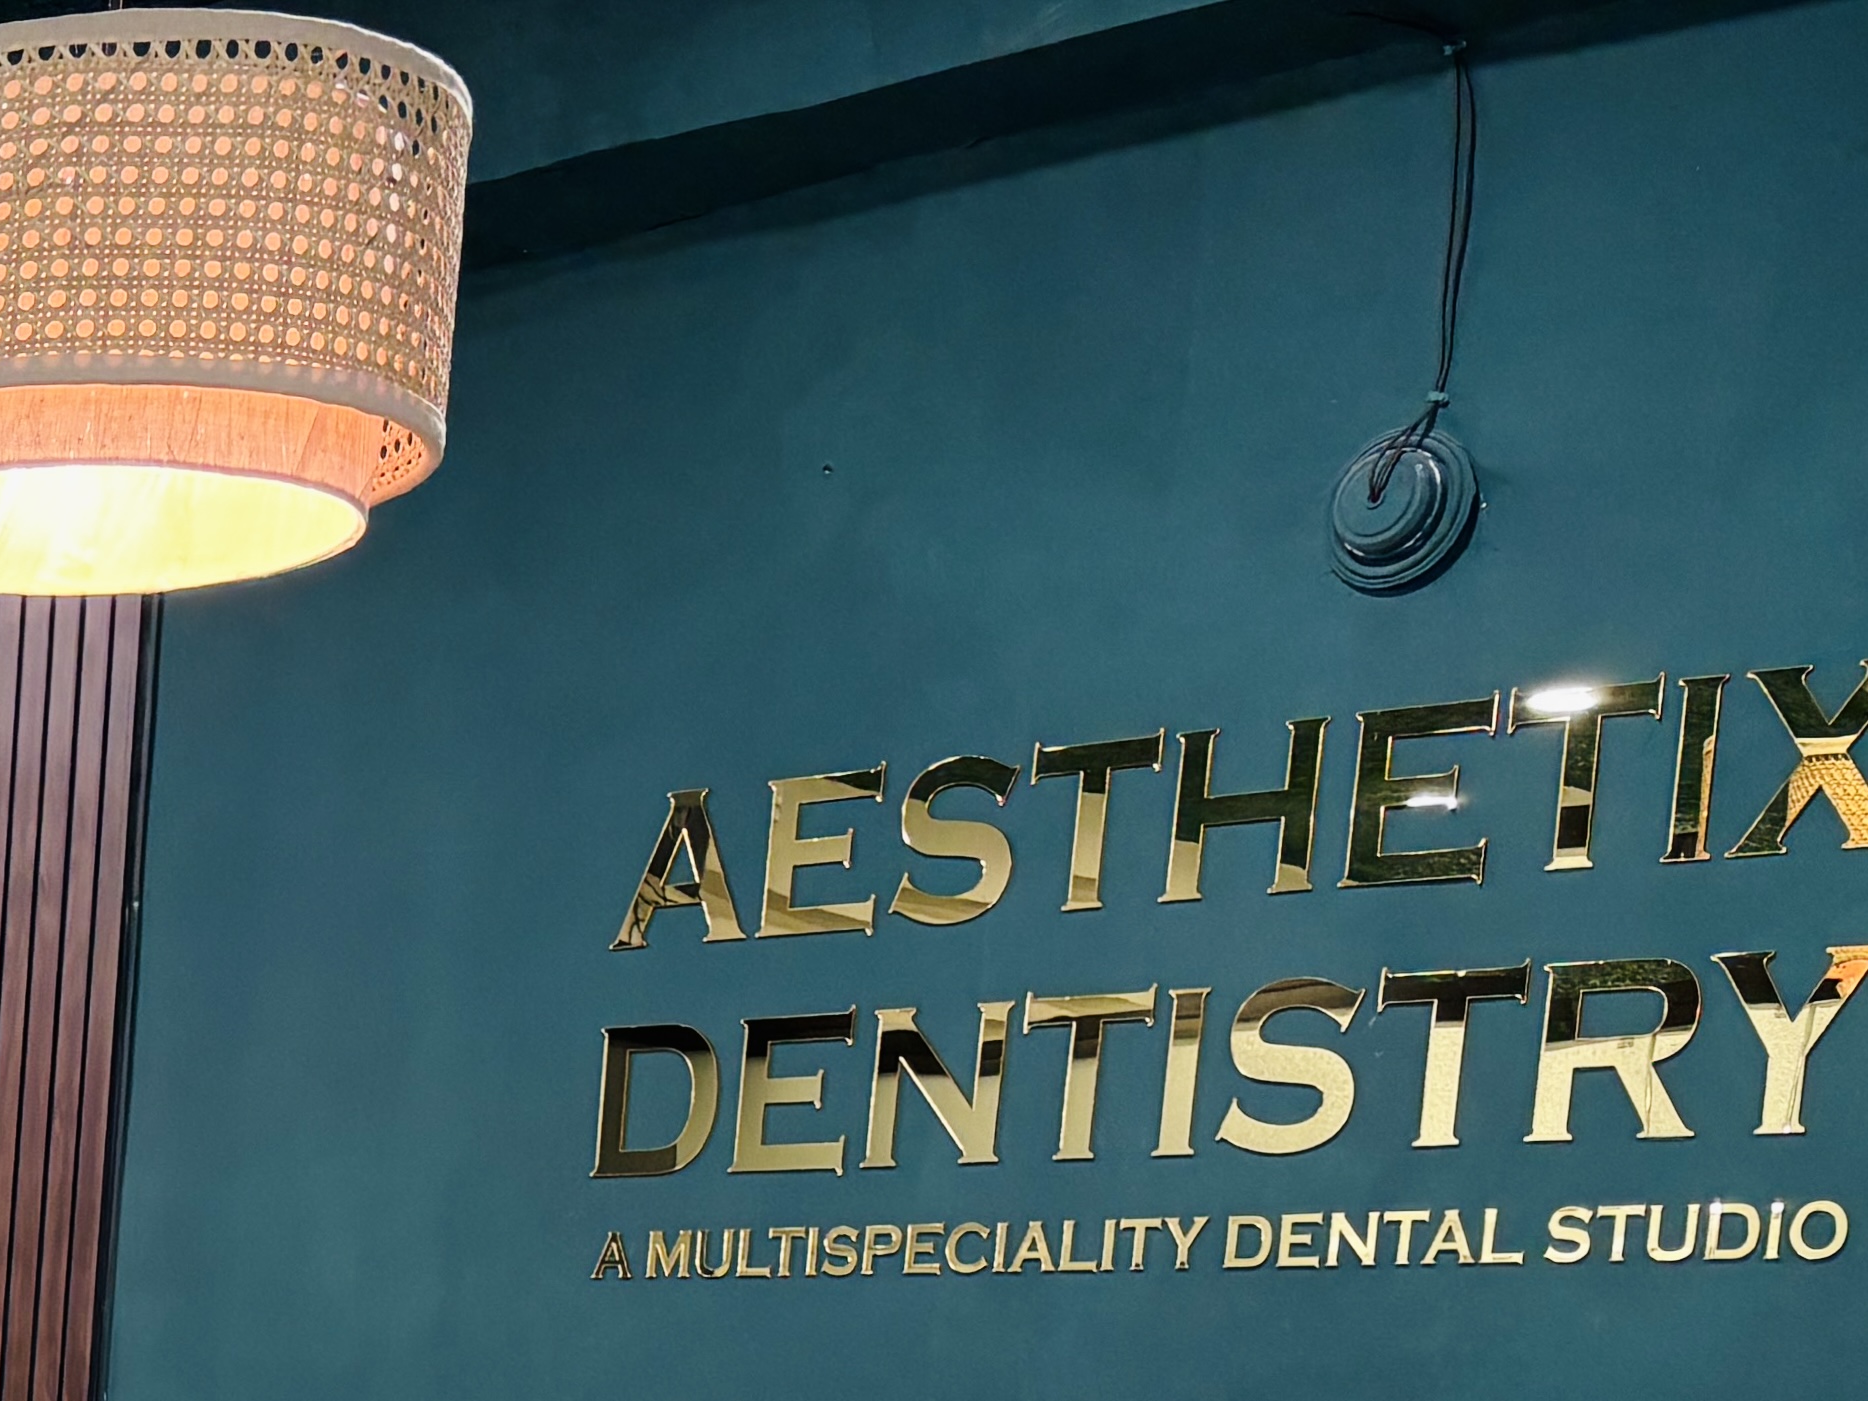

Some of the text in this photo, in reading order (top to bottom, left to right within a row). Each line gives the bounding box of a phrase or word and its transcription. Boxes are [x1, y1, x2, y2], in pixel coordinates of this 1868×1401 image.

[609, 659, 1868, 951] AESTHETIX
[589, 944, 1868, 1178] DENTISTRY
[590, 1199, 1849, 1280] A MULTISPECIALITY DENTAL STUDIO
